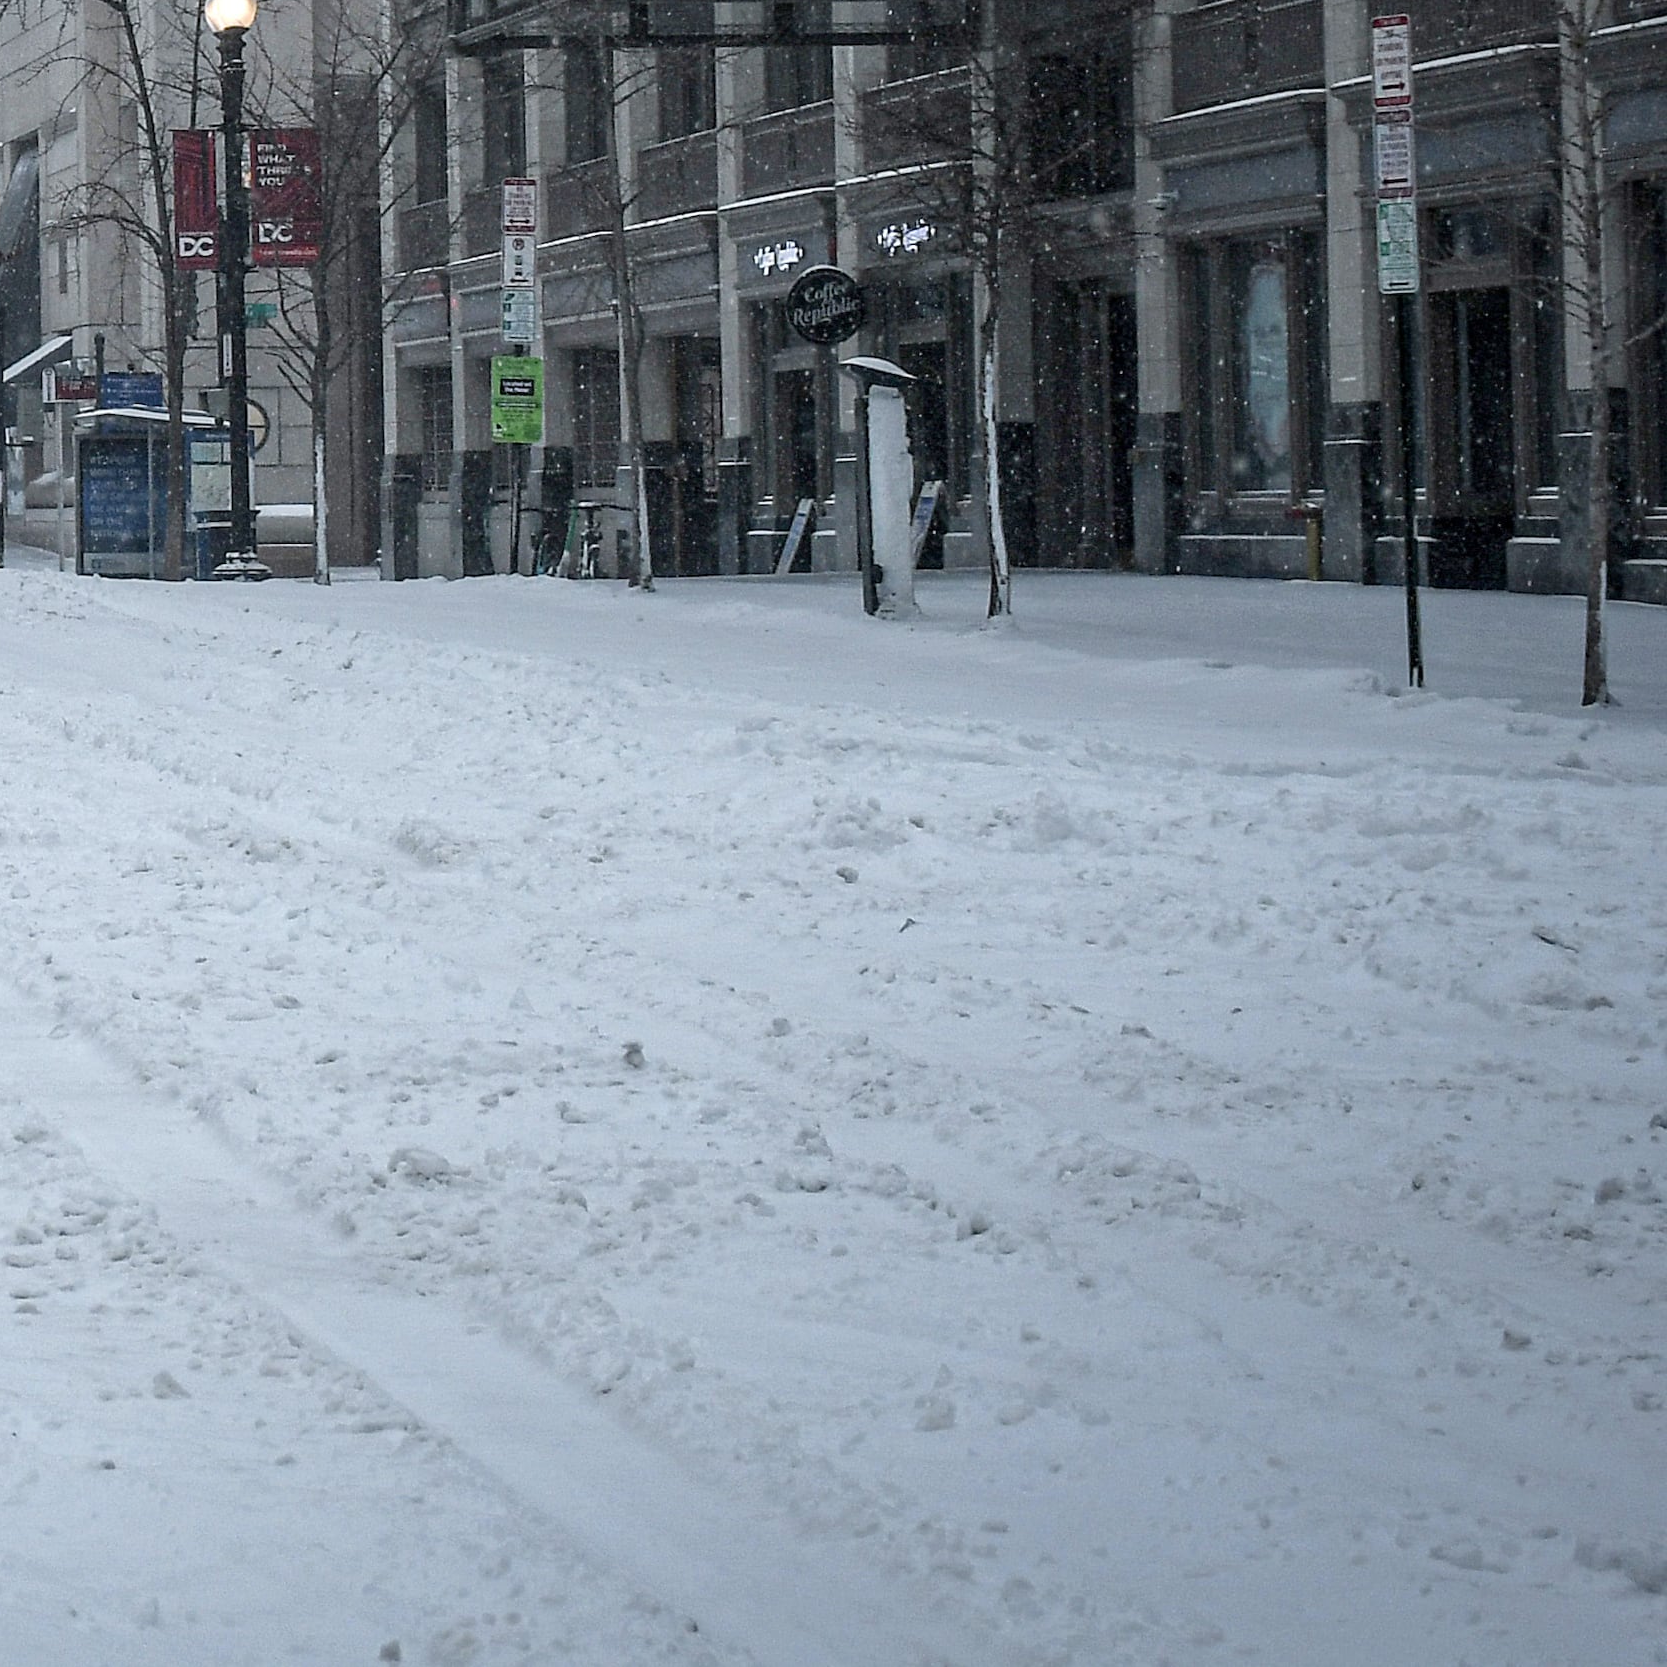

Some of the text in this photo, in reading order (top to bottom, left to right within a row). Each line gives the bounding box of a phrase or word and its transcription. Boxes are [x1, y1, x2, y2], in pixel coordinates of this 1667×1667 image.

[258, 222, 293, 243] DC
[178, 236, 214, 257] DC
[804, 283, 848, 303] Coffee
[793, 296, 860, 327] Republic
